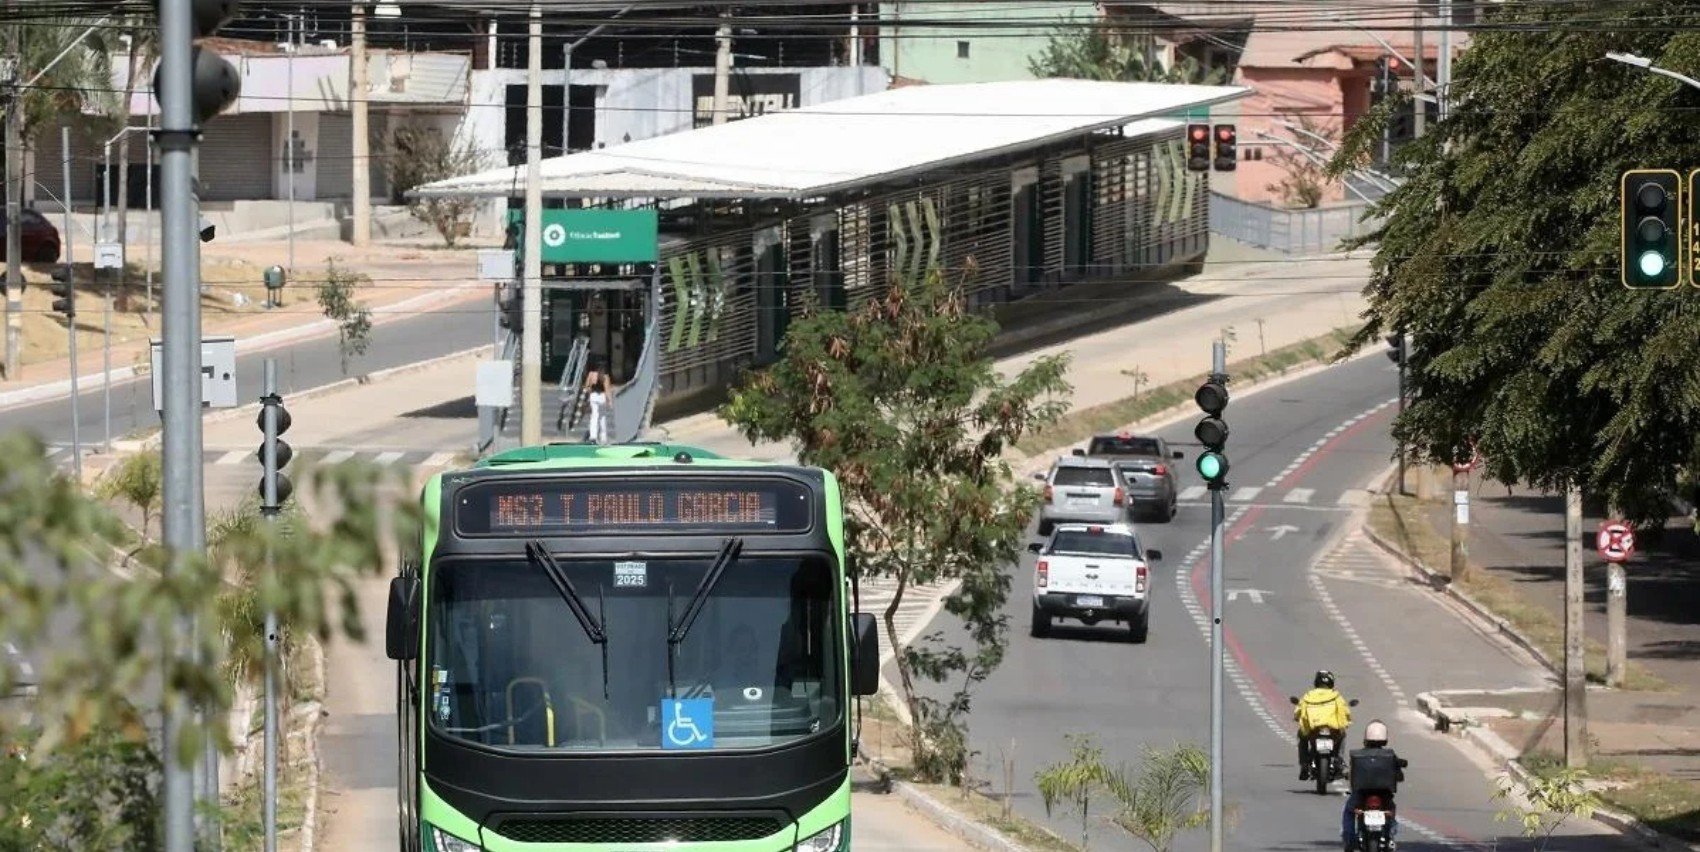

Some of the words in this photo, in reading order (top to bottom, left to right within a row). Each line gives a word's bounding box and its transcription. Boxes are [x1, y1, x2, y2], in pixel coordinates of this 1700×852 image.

[560, 493, 575, 524] T
[588, 493, 664, 524] PAULO
[677, 491, 760, 523] GARCIA
[616, 575, 644, 585] 2025
